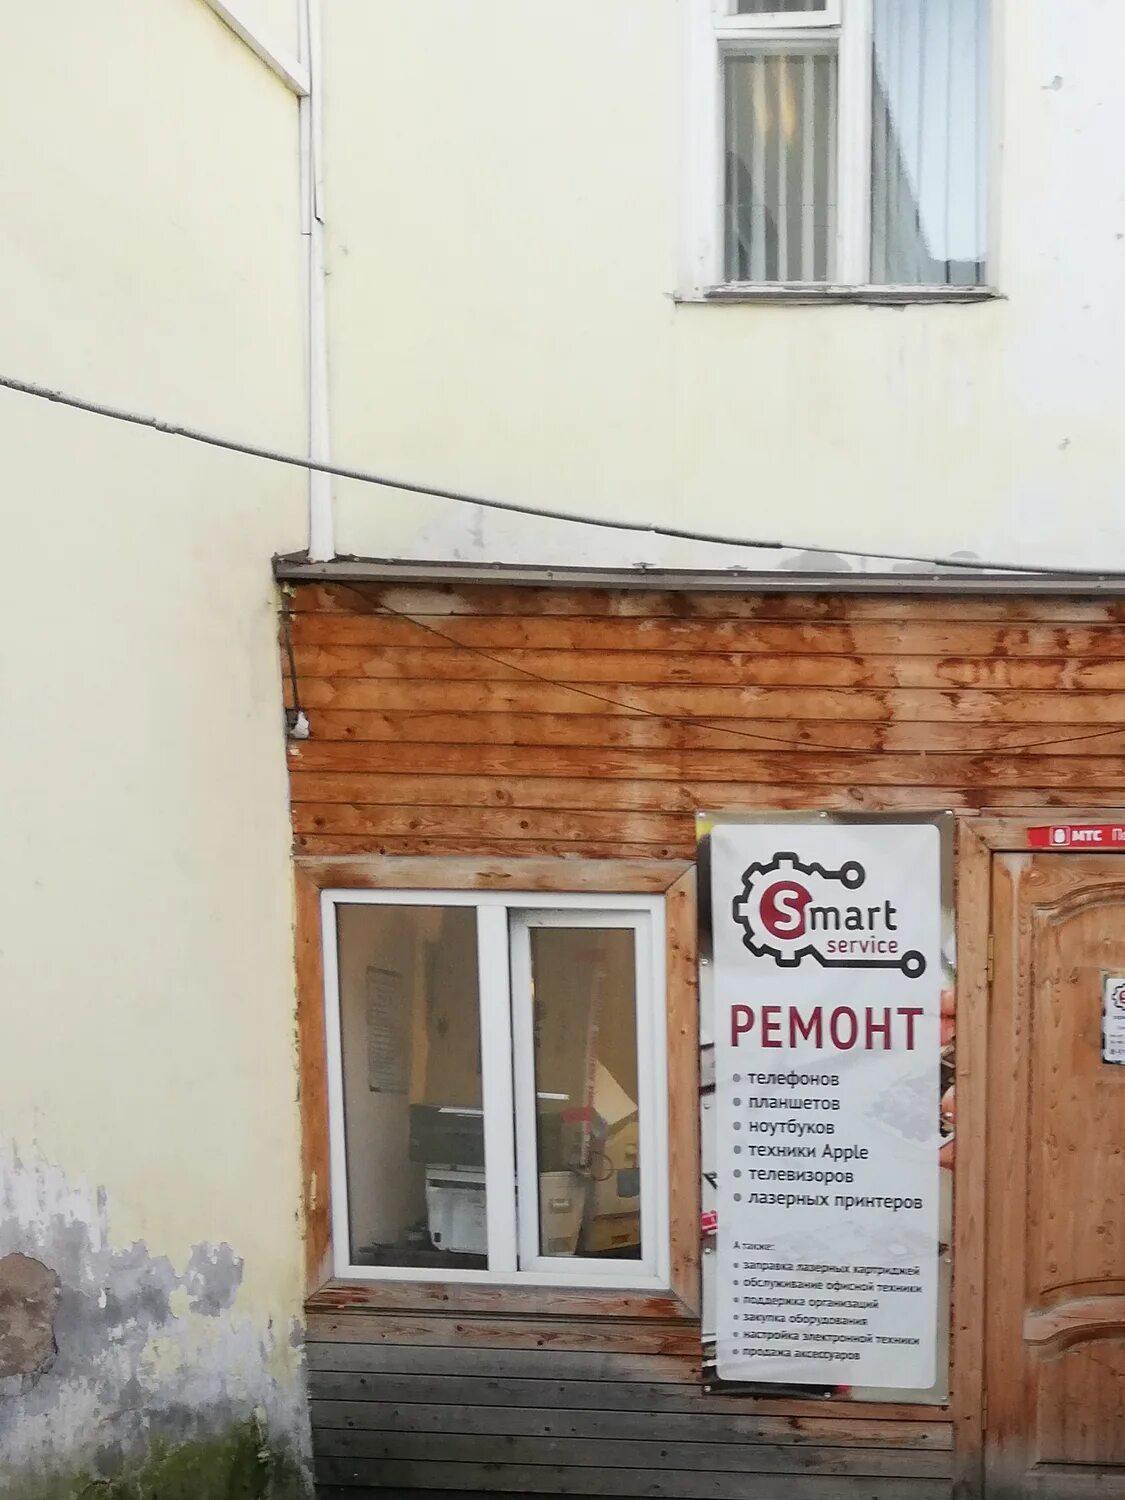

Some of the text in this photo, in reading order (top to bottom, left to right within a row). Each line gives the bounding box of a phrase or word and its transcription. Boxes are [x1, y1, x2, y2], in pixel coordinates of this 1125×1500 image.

[1072, 829, 1102, 841] МТС
[772, 889, 898, 931] Smart
[827, 935, 898, 953] service
[731, 1004, 924, 1050] РЕМОНТ
[747, 1070, 839, 1089] телефонов
[748, 1096, 840, 1111] планшетов
[749, 1119, 835, 1137] ноутбуков
[749, 1143, 869, 1162] техники Apple
[749, 1167, 854, 1186] телевизоров
[748, 1192, 923, 1212] лазерных принтеров
[743, 1261, 920, 1276] заправка лазерных картриджей
[743, 1277, 922, 1293] обслуживание офисной техники
[743, 1296, 878, 1310] поддержка организаций
[743, 1313, 868, 1326] закупка оборудования
[743, 1330, 920, 1345] настройка электронной техники
[743, 1347, 860, 1361] продажа аксессуаров
